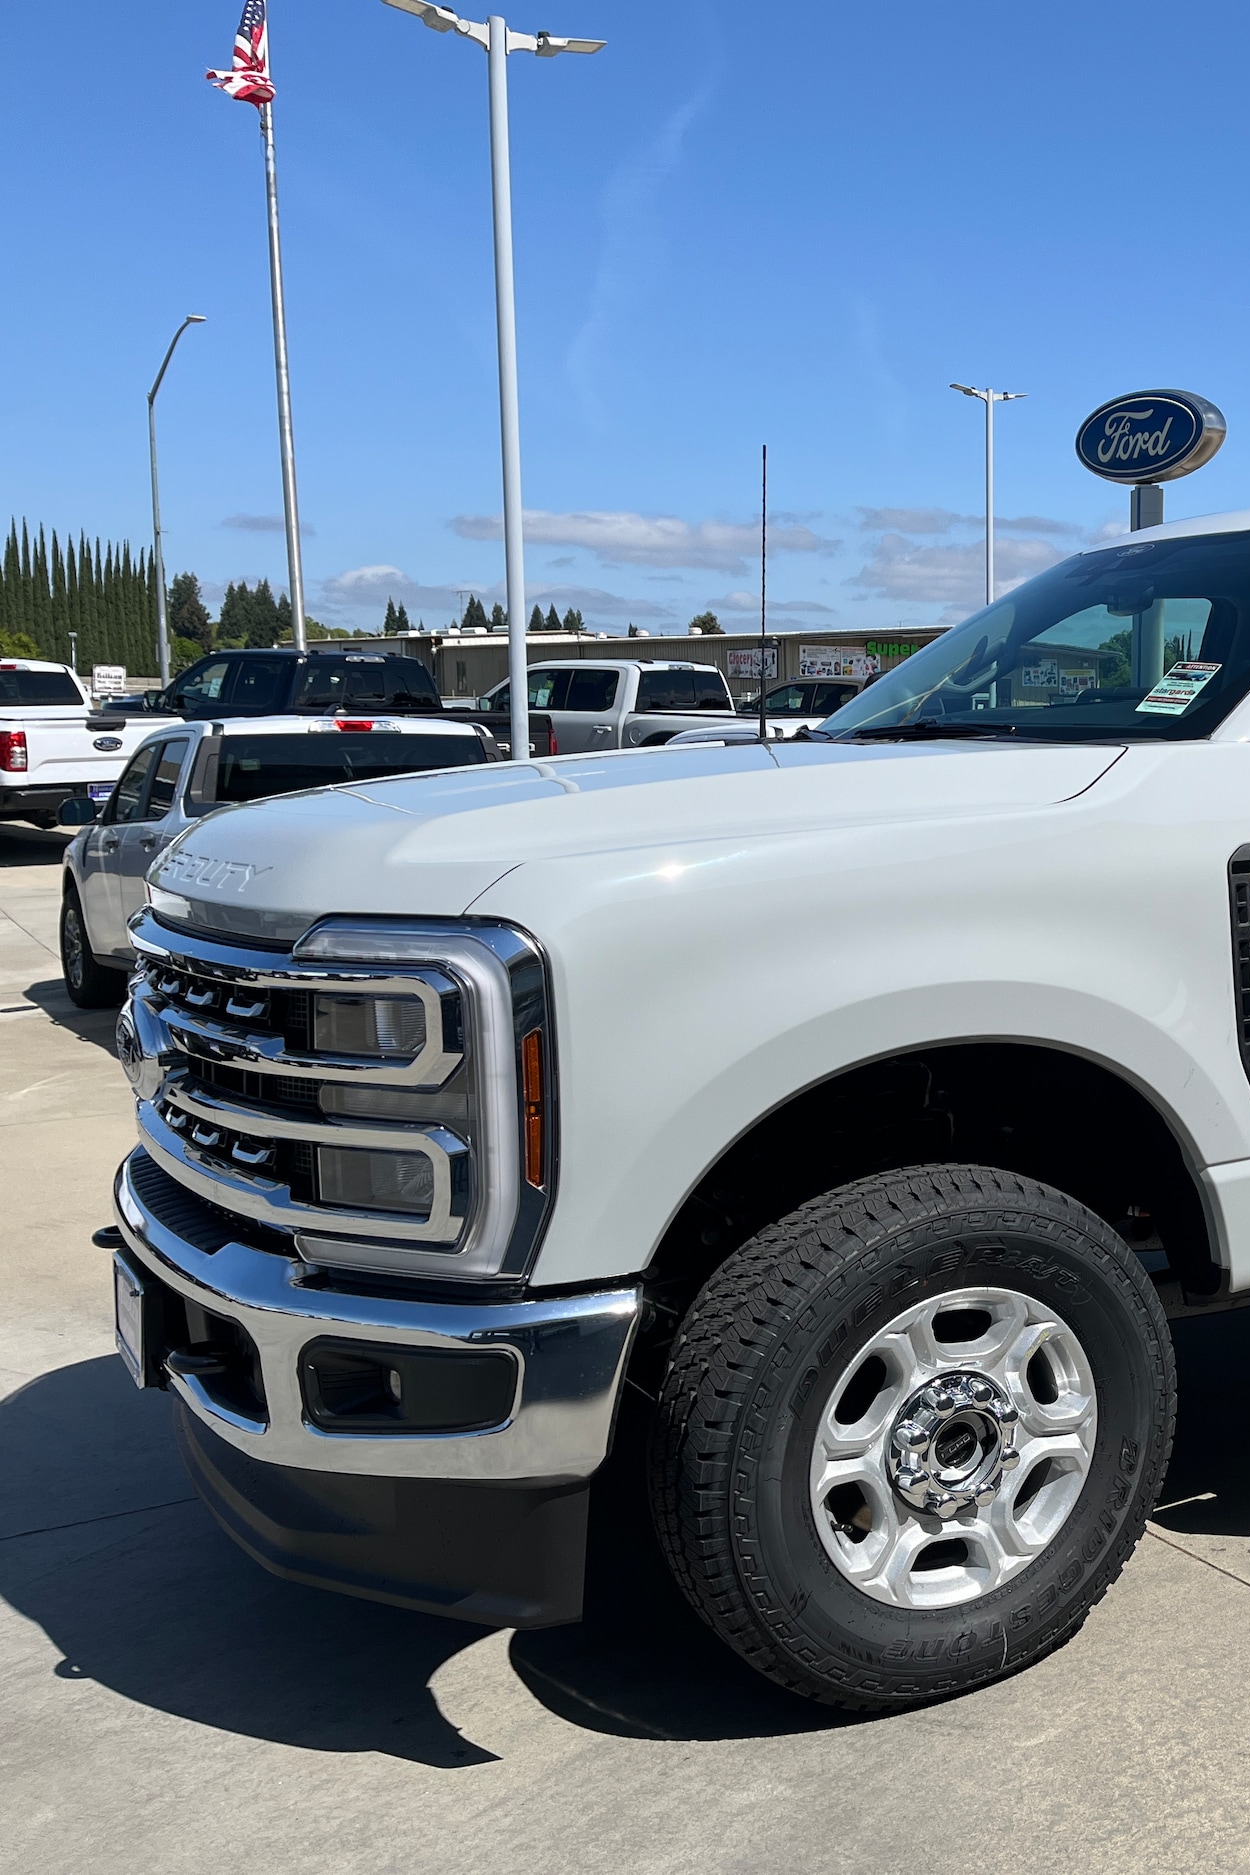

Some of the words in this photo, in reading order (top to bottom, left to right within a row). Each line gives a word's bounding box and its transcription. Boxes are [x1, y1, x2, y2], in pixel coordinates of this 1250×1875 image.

[1097, 408, 1173, 463] Ford
[866, 641, 920, 657] Super
[179, 856, 274, 892] DUTY
[788, 1244, 1009, 1420] DUELER
[881, 1434, 1139, 1664] BRIDGESTONE
